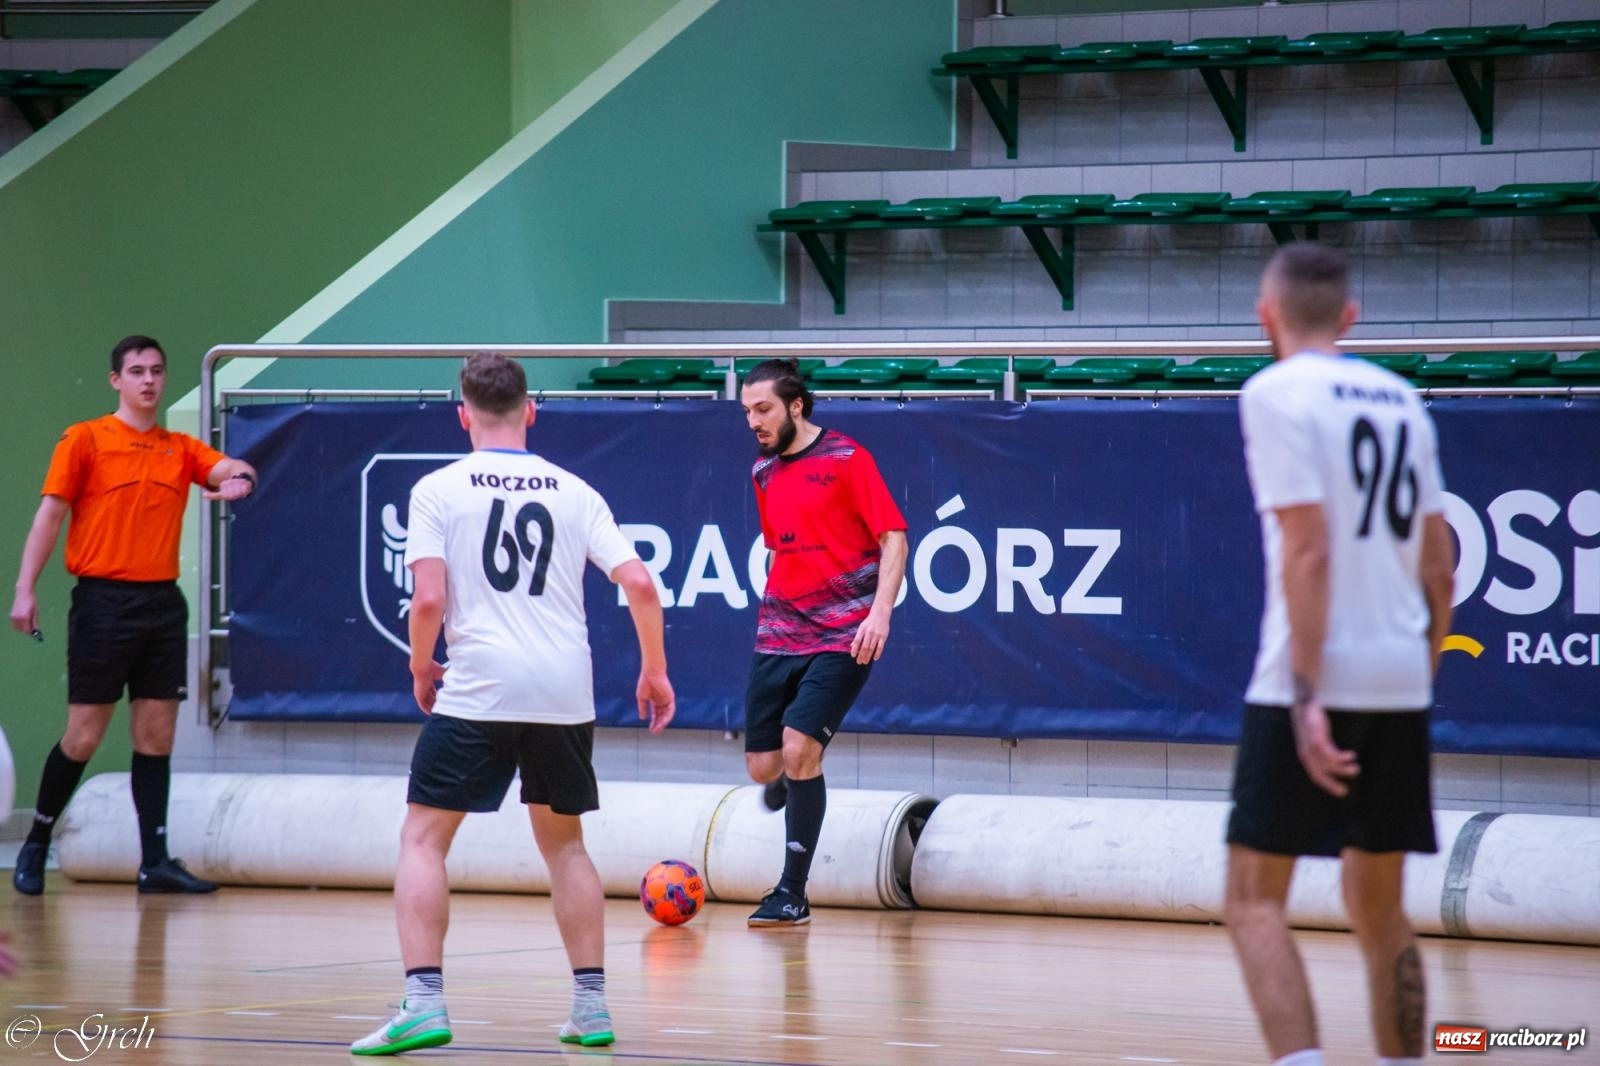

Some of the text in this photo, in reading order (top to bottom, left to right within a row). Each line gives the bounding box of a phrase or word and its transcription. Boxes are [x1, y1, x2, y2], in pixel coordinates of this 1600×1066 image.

[470, 473, 559, 491] KOCZOR
[1350, 416, 1418, 540] 96
[482, 497, 554, 596] 69
[617, 494, 1122, 615] RAÓRZ
[1507, 631, 1600, 666] RACI
